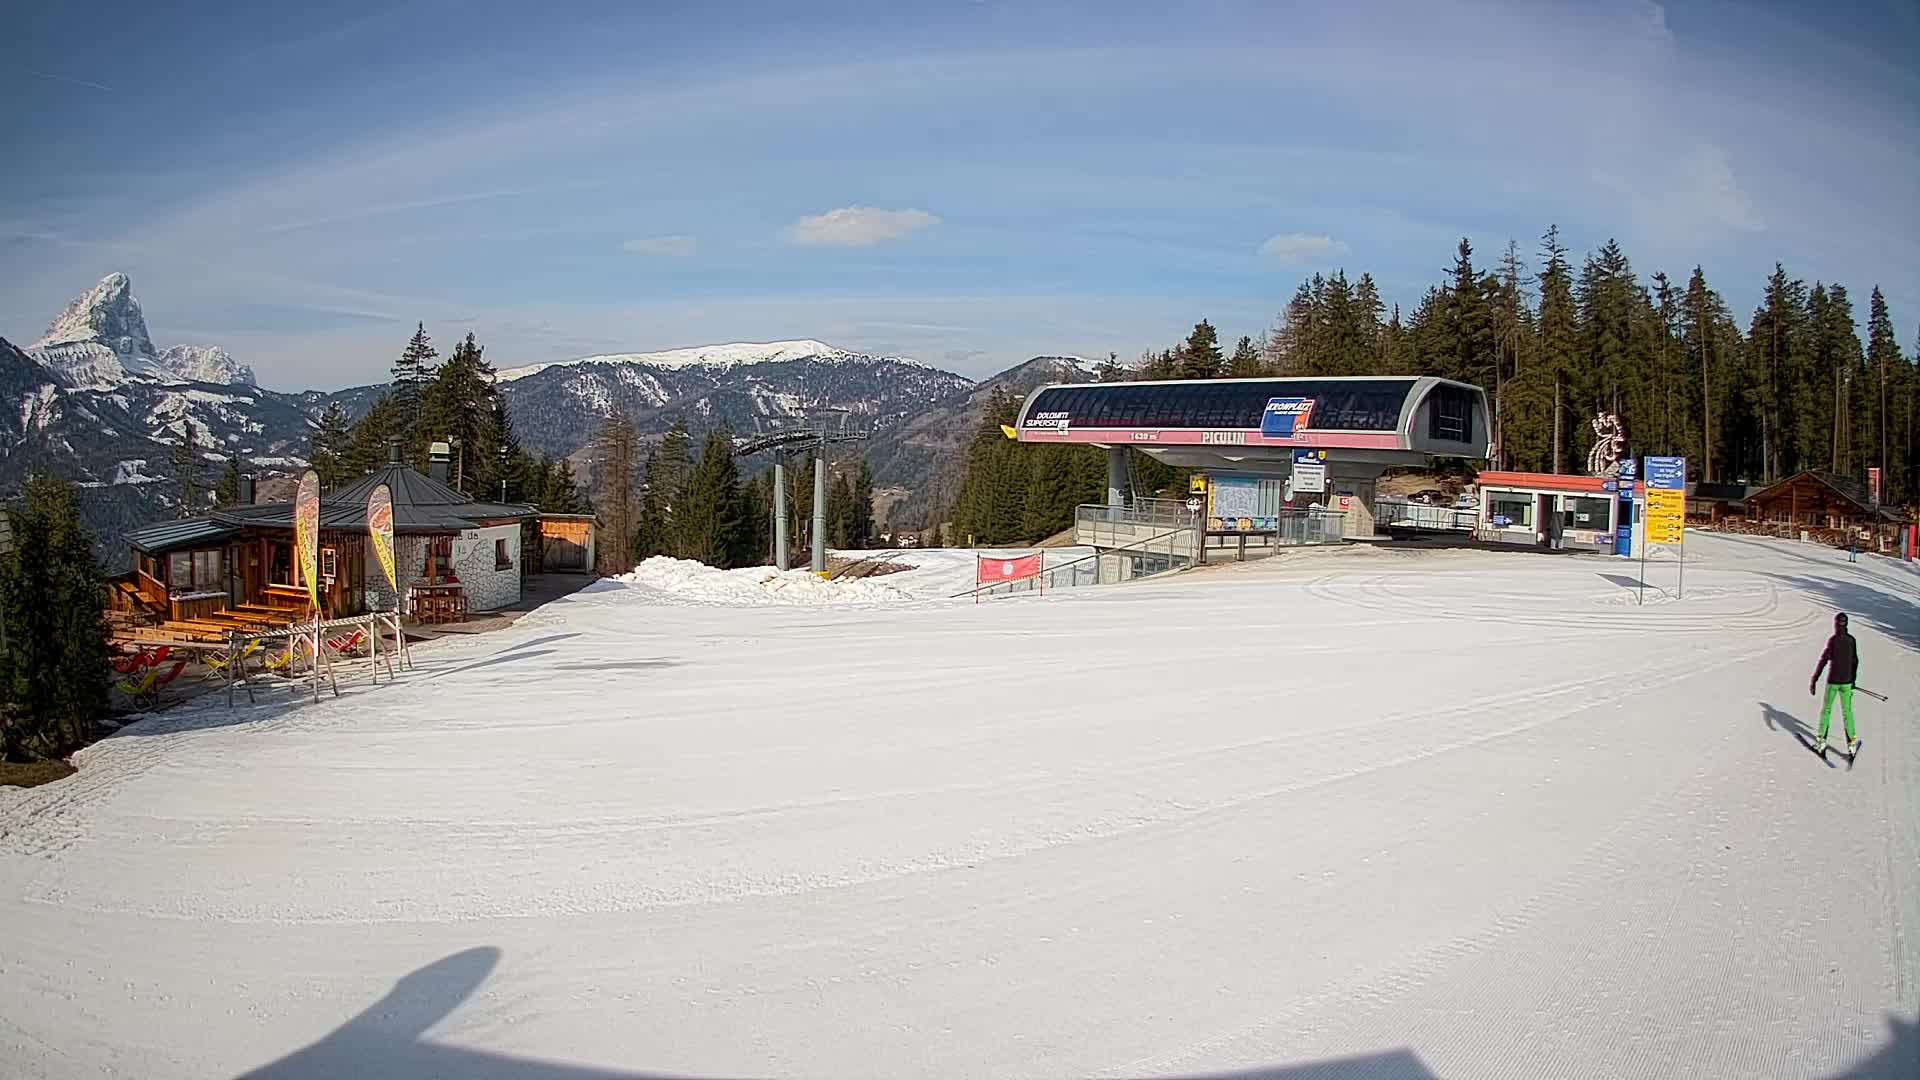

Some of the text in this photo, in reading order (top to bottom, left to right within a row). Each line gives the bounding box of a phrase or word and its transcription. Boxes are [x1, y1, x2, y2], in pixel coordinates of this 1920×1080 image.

[1036, 411, 1069, 419] DOLOMITI
[1025, 419, 1058, 427] SUPERSKI
[1202, 431, 1245, 445] PICULIN
